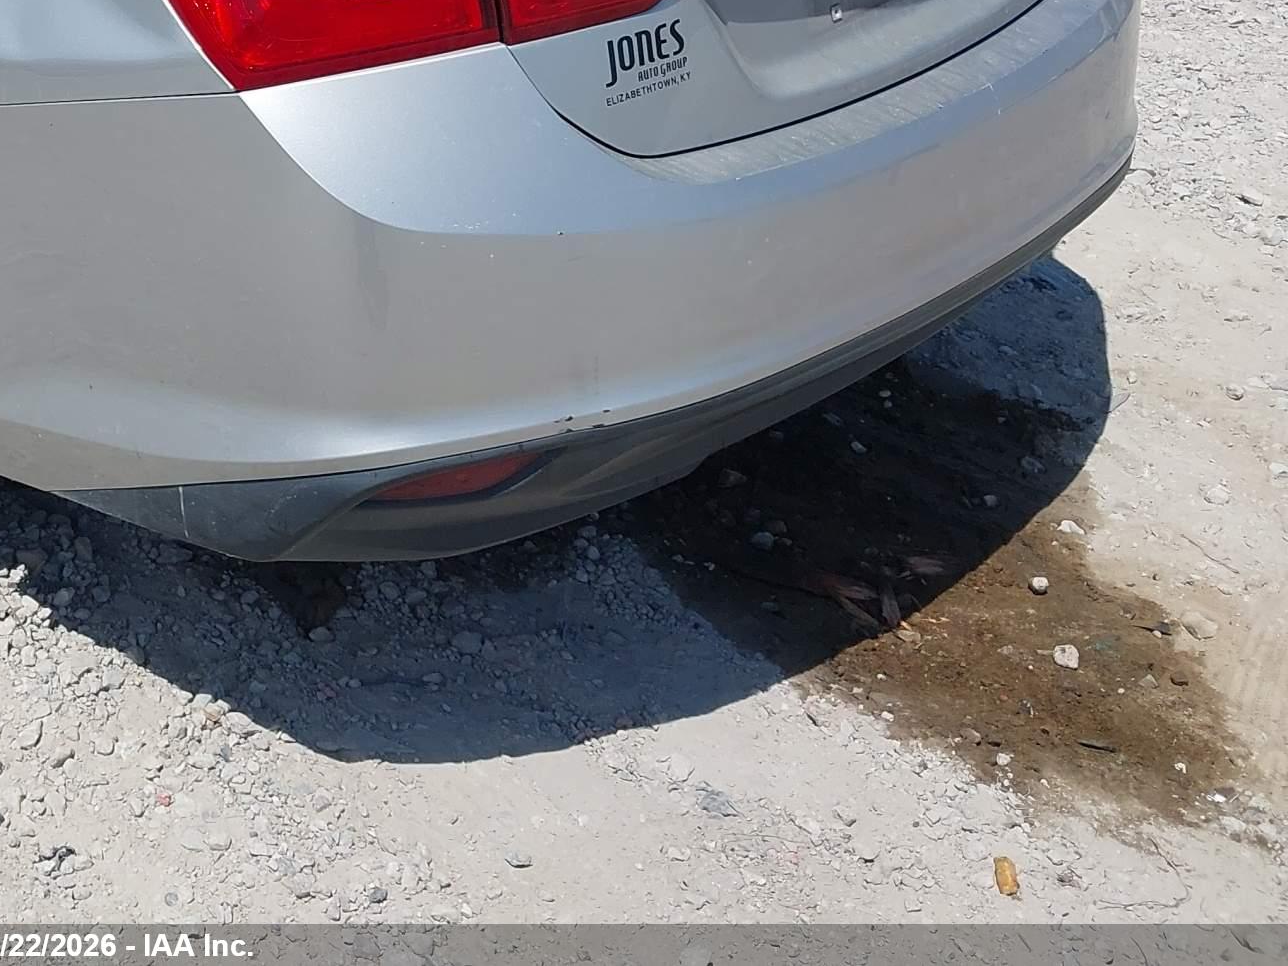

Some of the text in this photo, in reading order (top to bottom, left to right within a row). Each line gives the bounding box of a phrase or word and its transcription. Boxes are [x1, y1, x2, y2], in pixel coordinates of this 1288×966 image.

[605, 18, 685, 89] JONES
[637, 56, 688, 83] AUTO GROUP
[605, 71, 691, 107] ELIZABETHTOWN, KY
